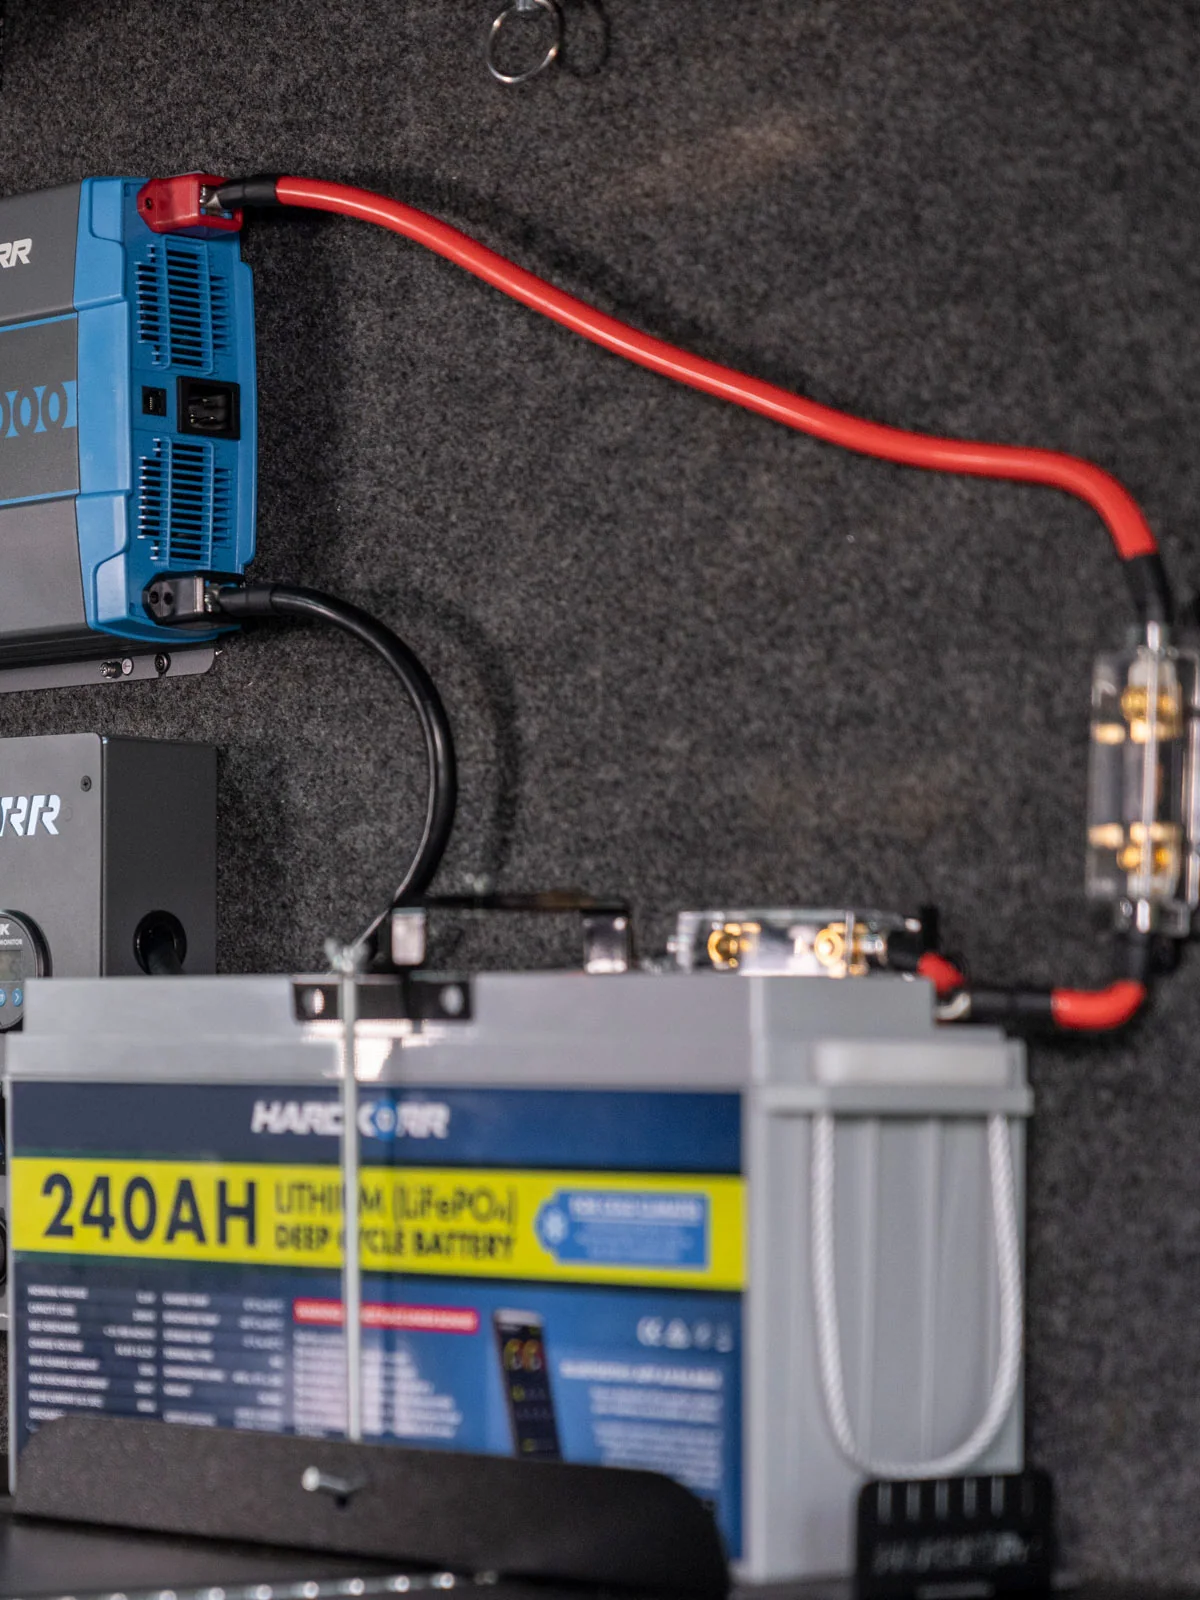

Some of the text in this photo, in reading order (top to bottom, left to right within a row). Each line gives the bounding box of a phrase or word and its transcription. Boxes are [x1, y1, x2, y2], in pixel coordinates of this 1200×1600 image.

[41, 1172, 257, 1247] 240AH
[274, 1181, 385, 1215] LITHIM
[274, 1223, 515, 1261] DEEP CLE BATTERY
